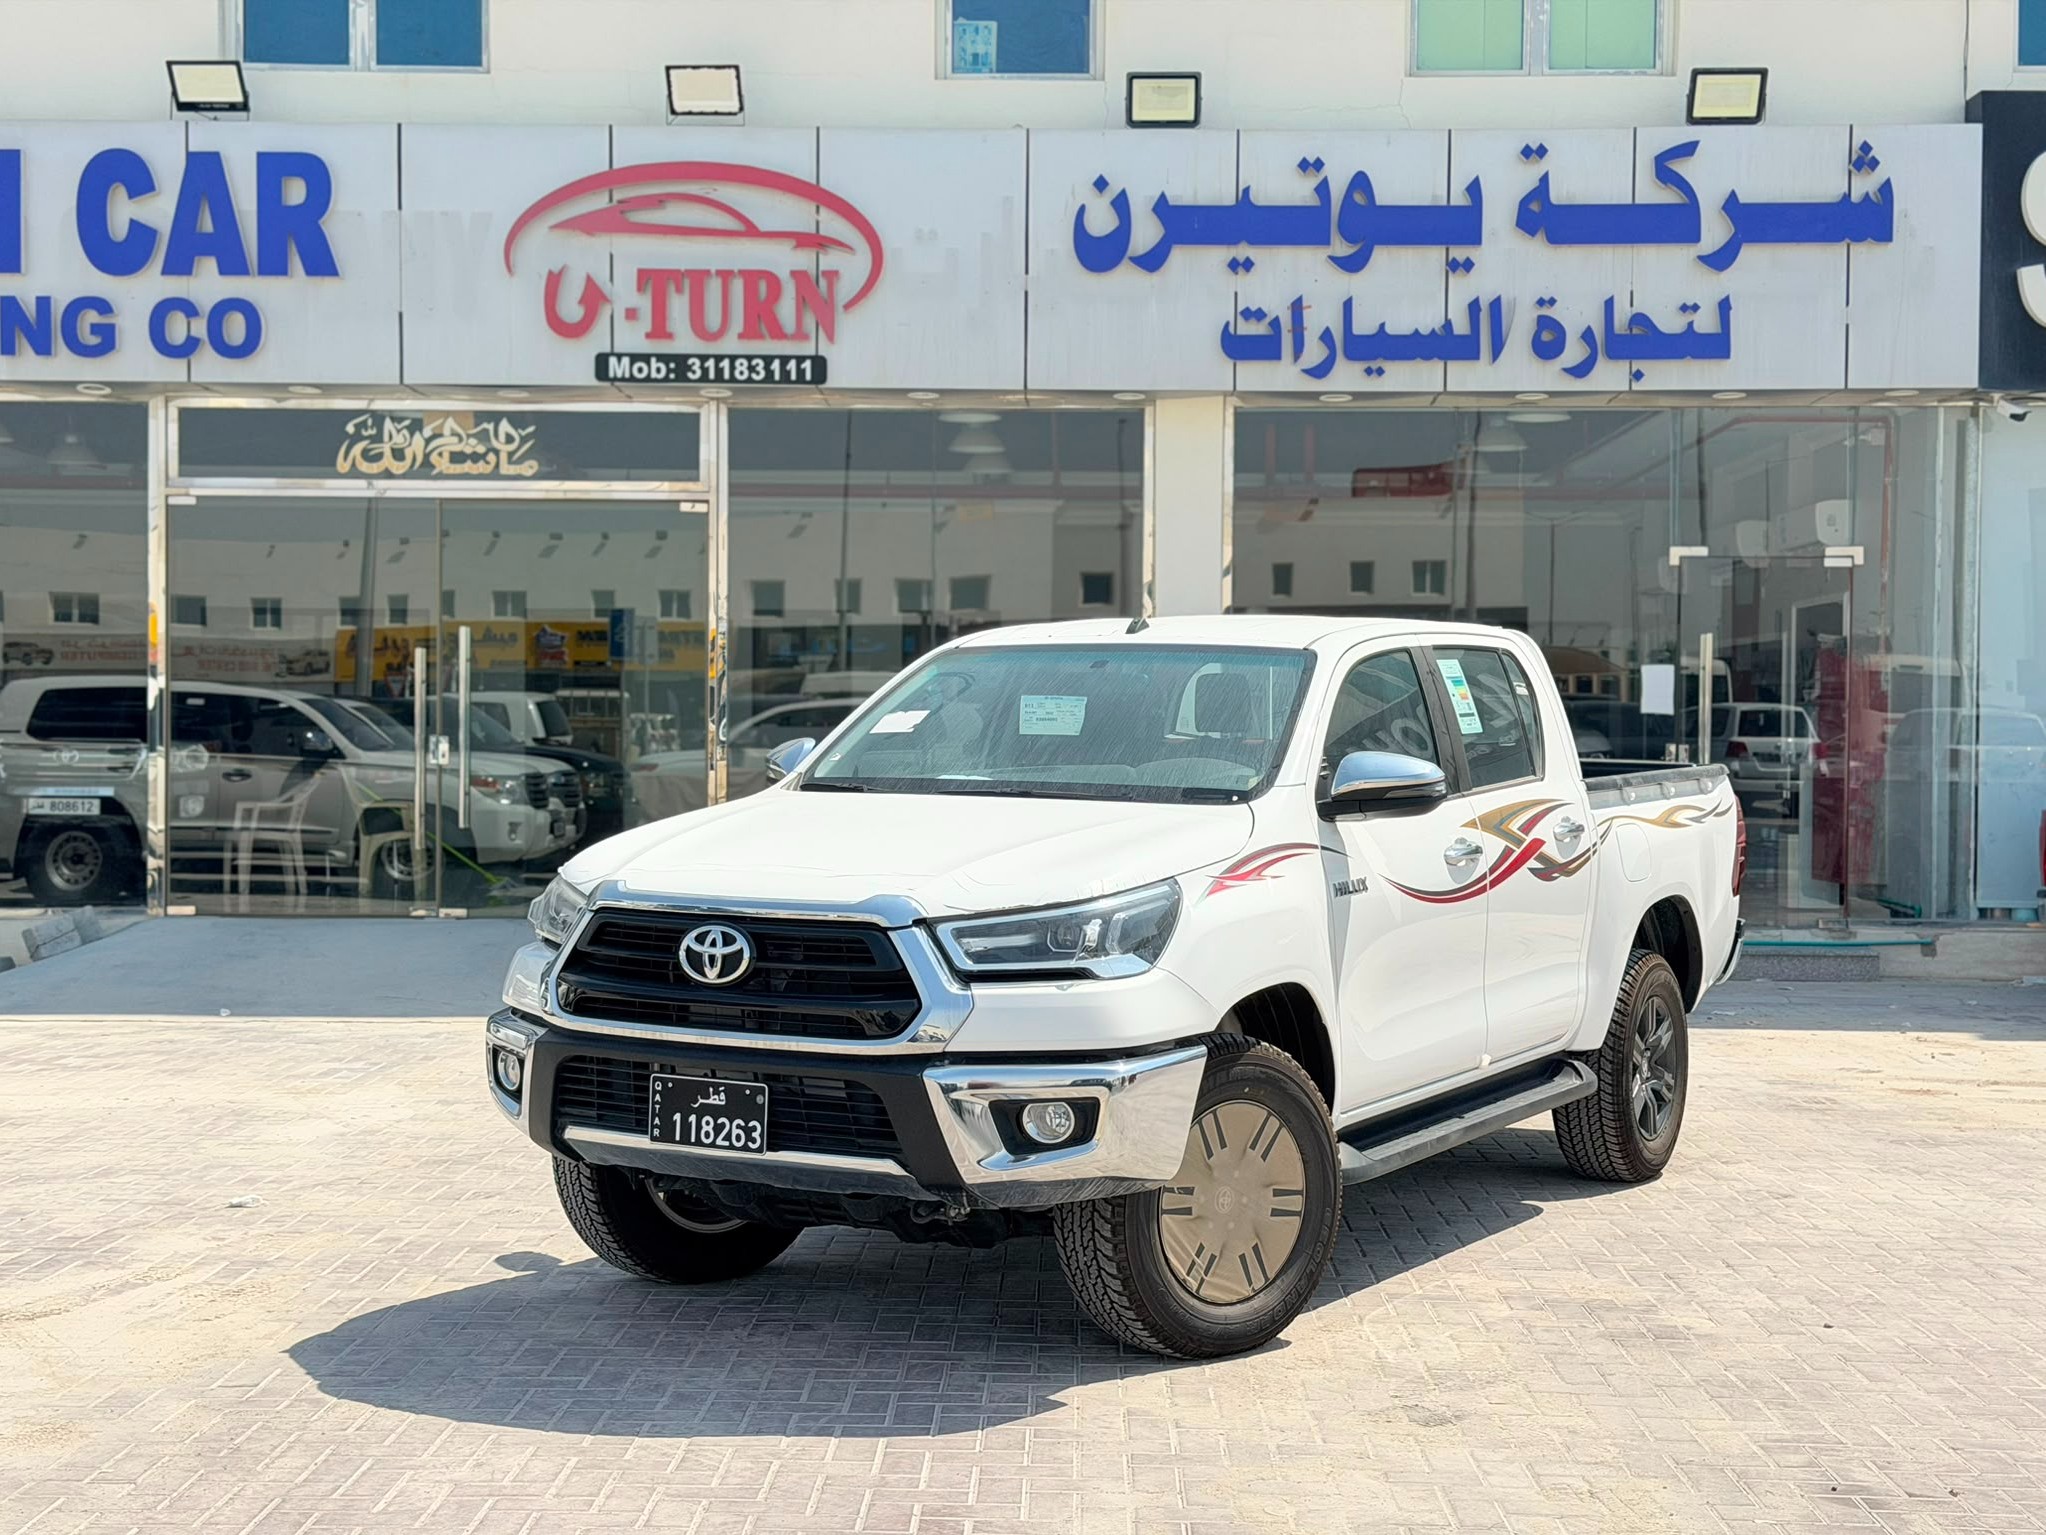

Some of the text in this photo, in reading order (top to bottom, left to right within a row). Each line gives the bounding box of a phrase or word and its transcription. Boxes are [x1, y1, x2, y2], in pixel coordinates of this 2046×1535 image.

[76, 147, 341, 278] CAR
[1073, 156, 1483, 274] يوتيرن
[1515, 140, 1895, 273] شركة
[148, 297, 264, 359] CO
[1220, 294, 1733, 383] لتجارة السيارات
[607, 356, 813, 382] Mob: 31183111
[49, 800, 95, 813] 808612
[653, 1080, 662, 1138] QATAR
[690, 1086, 726, 1108] قطر
[672, 1111, 762, 1150] 118263
